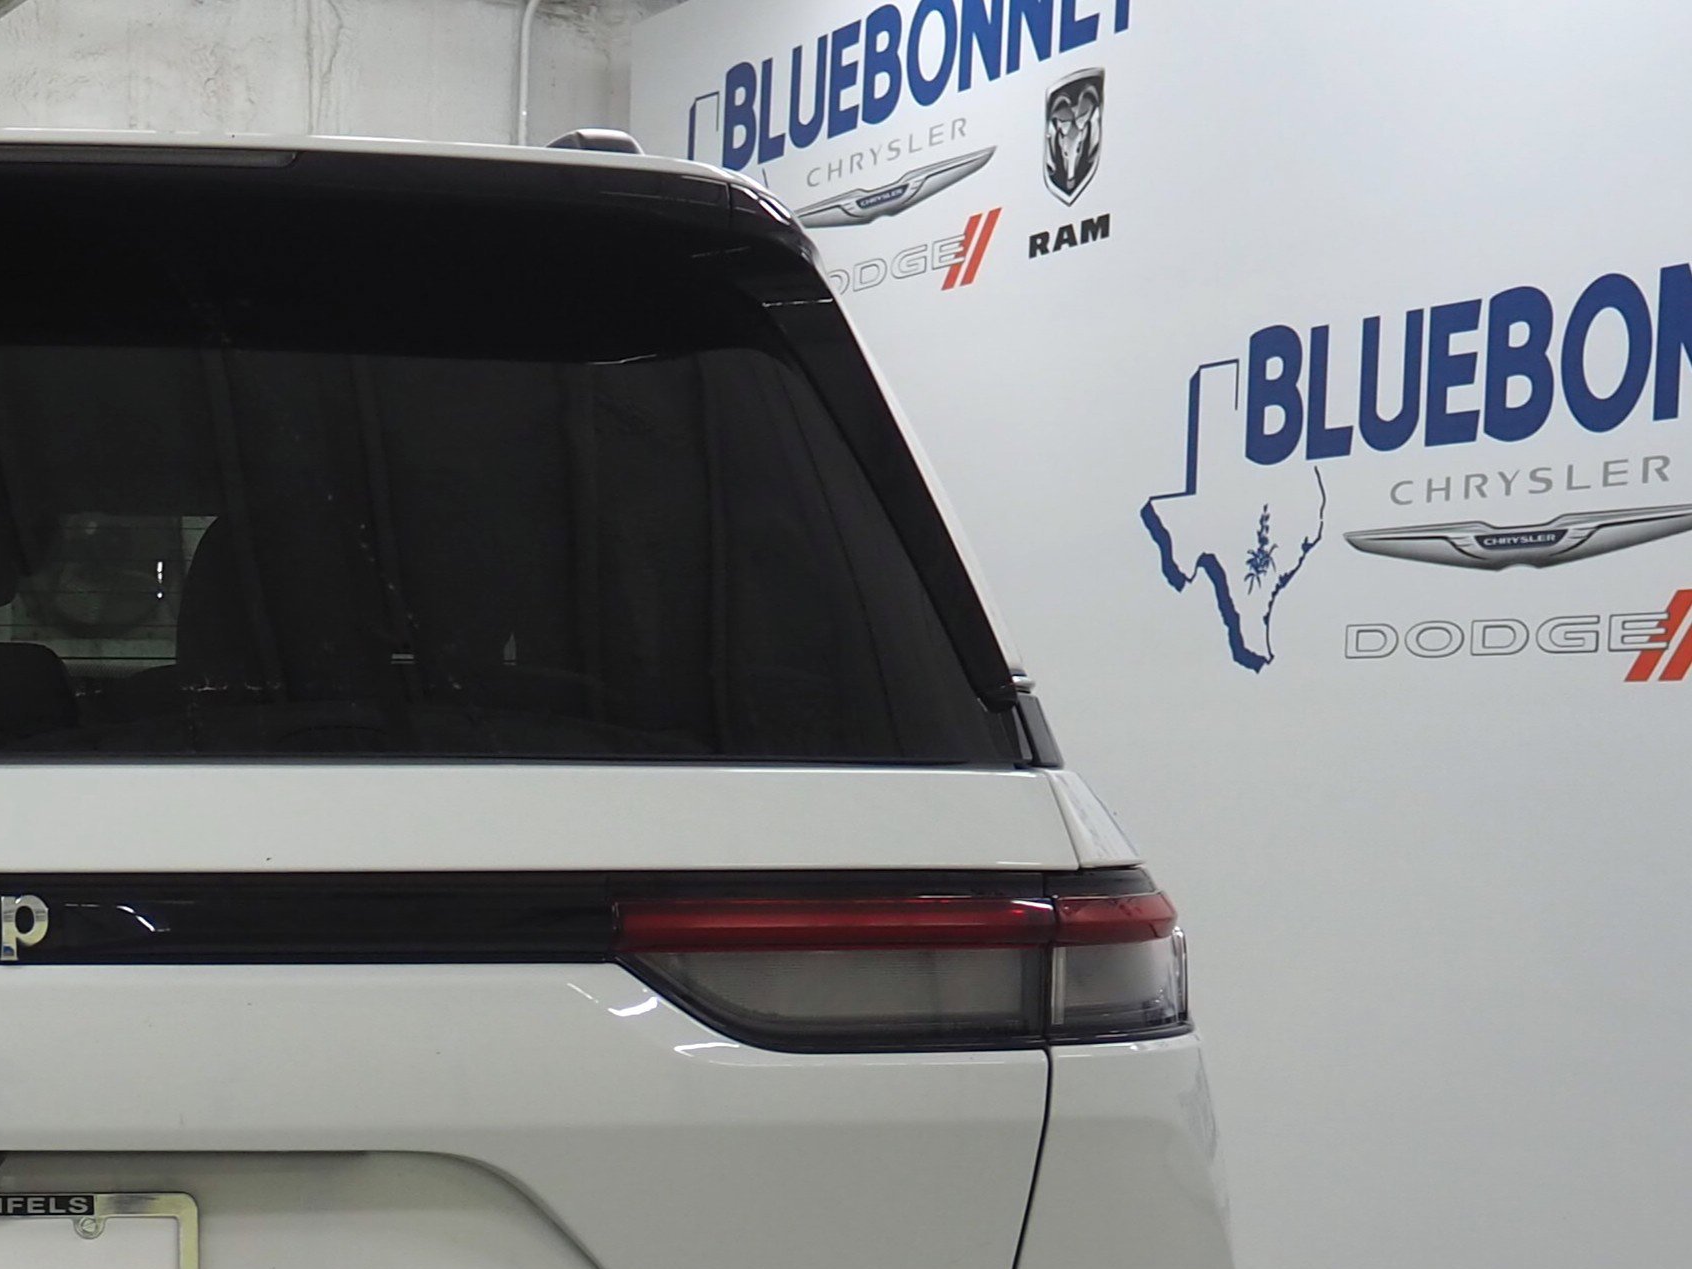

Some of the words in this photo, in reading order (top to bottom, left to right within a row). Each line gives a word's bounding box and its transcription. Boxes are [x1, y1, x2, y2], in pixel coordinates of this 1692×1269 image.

[806, 117, 968, 188] CHRYSLER
[1028, 213, 1111, 259] RAM
[827, 234, 966, 295] ODGE
[1390, 455, 1671, 505] CHRYSLER
[1483, 533, 1556, 546] CHRYSLER
[1344, 612, 1669, 659] DODGE
